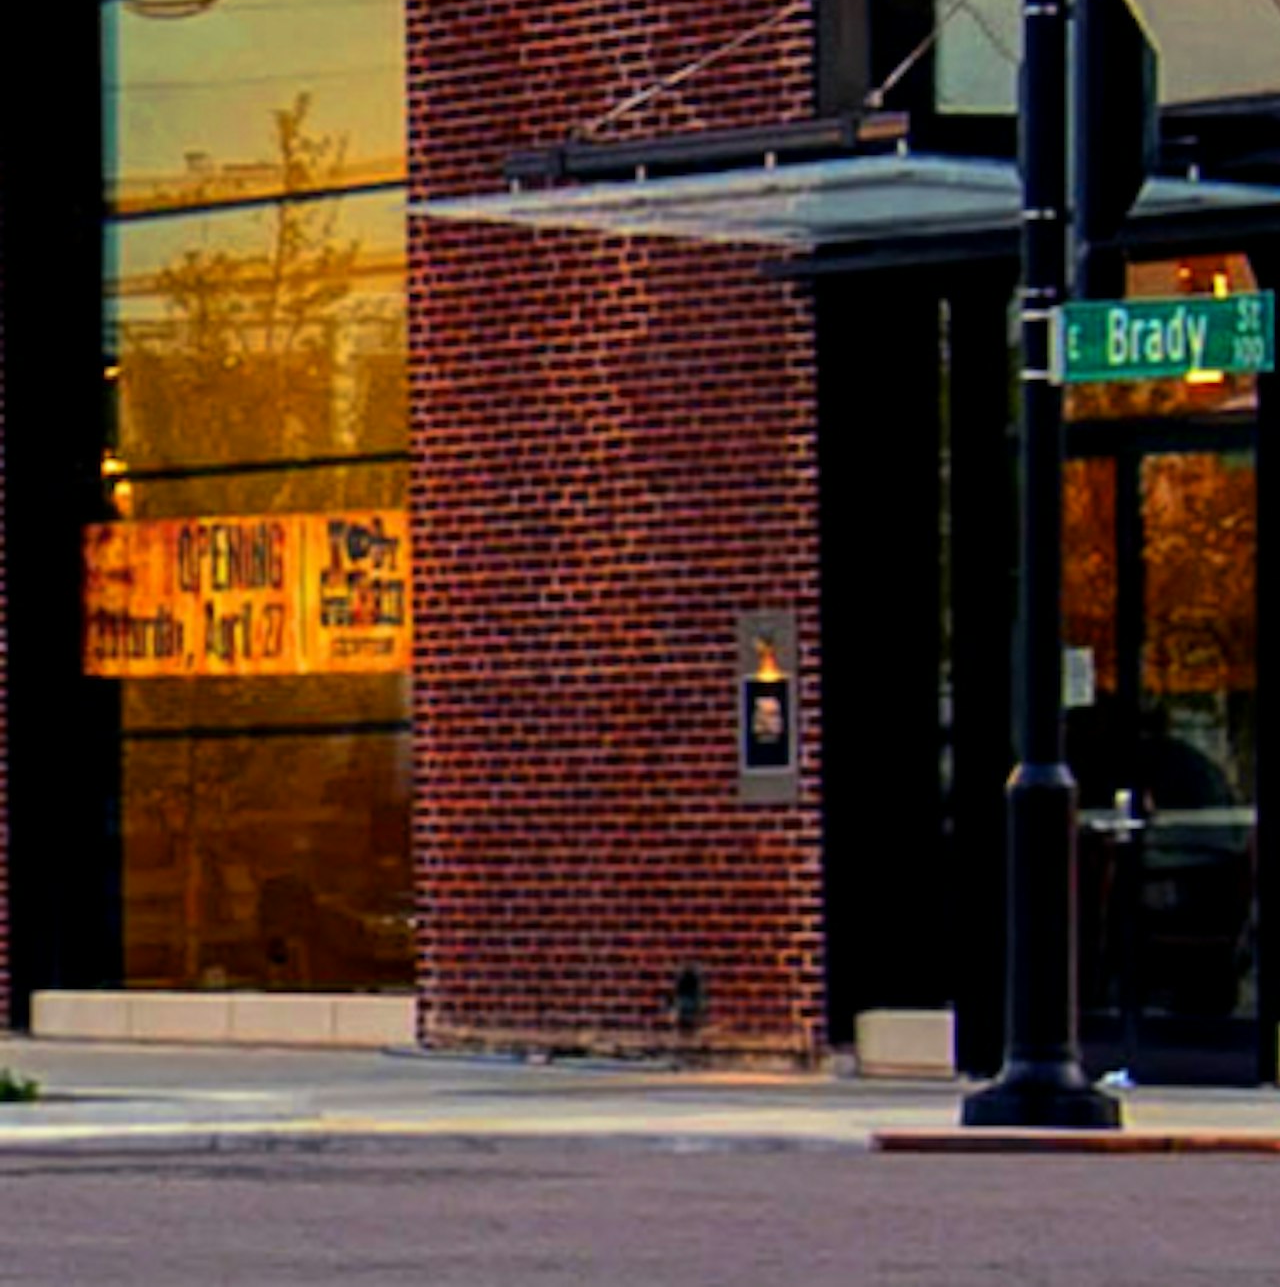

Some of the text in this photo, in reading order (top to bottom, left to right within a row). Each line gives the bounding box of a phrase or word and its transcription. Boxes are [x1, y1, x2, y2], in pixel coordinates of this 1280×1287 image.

[1066, 305, 1207, 373] E Brady
[179, 523, 285, 592] OPENING
